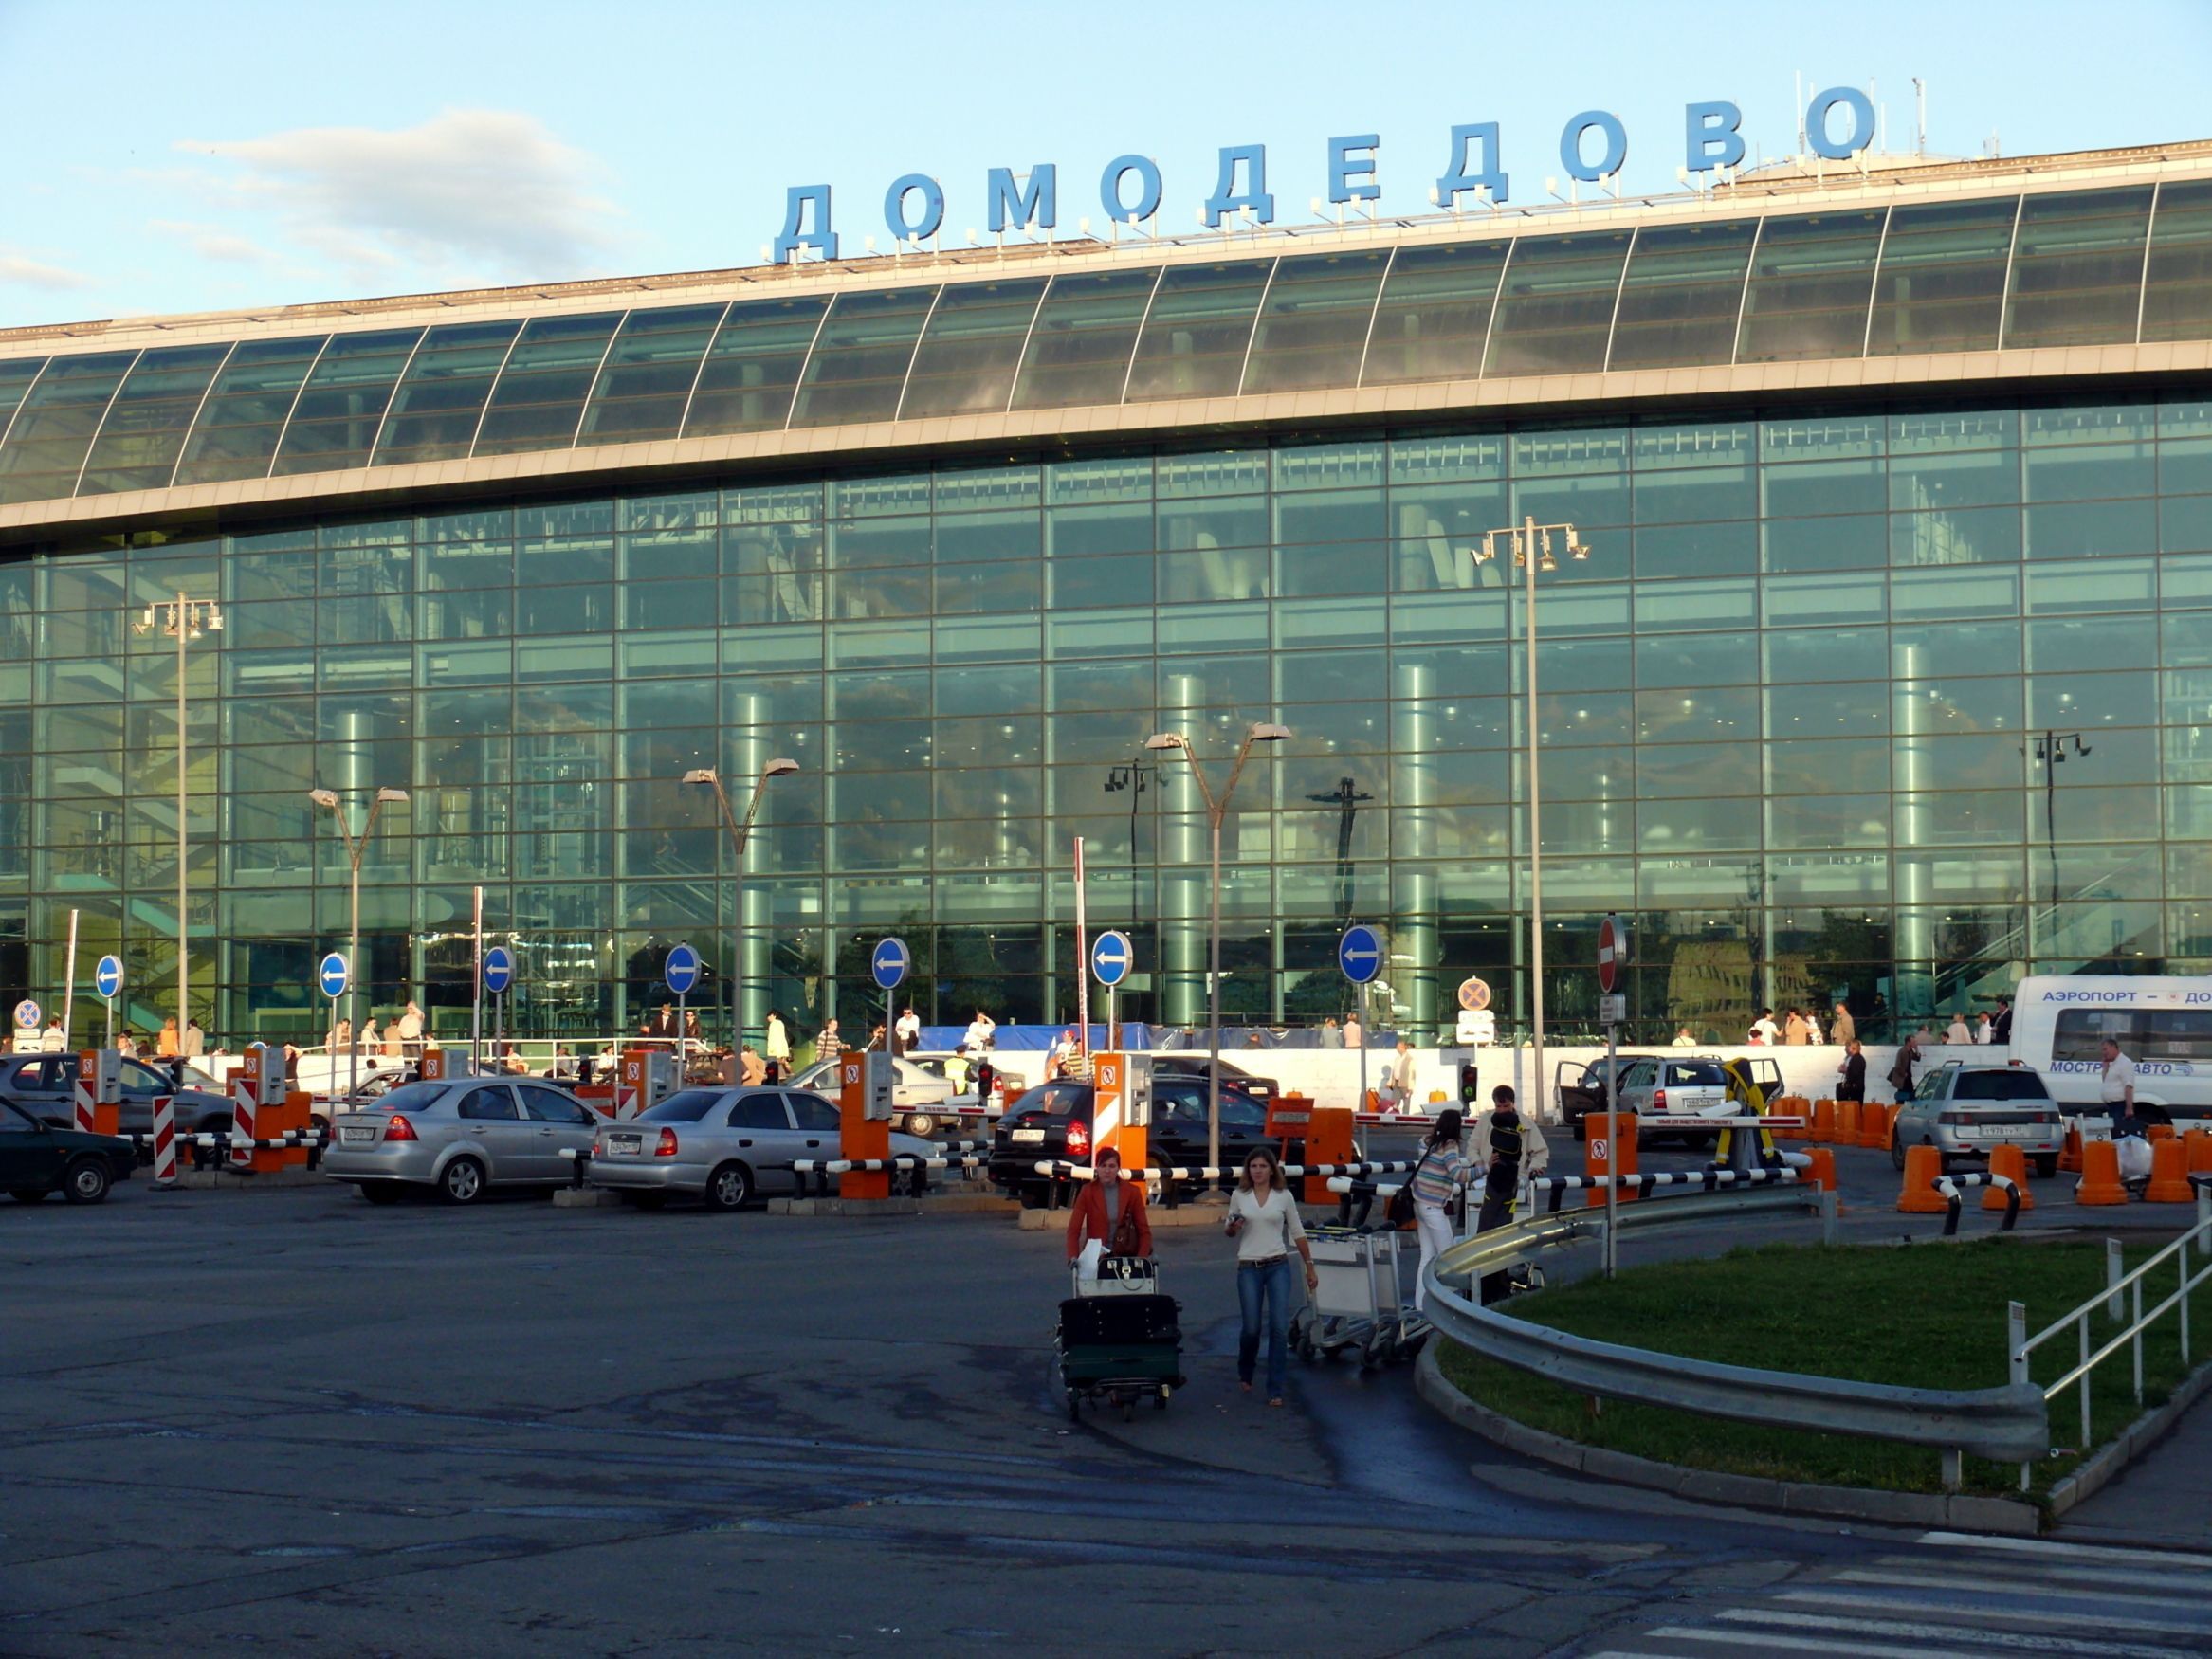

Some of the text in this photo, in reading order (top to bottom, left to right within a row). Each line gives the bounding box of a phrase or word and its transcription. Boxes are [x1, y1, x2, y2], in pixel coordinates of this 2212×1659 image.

[774, 86, 1875, 264] ДОМОДЕДОВО
[2042, 991, 2137, 1002] АЭРОПОРТ
[2050, 1061, 2172, 1075] МОСТРАВТО
